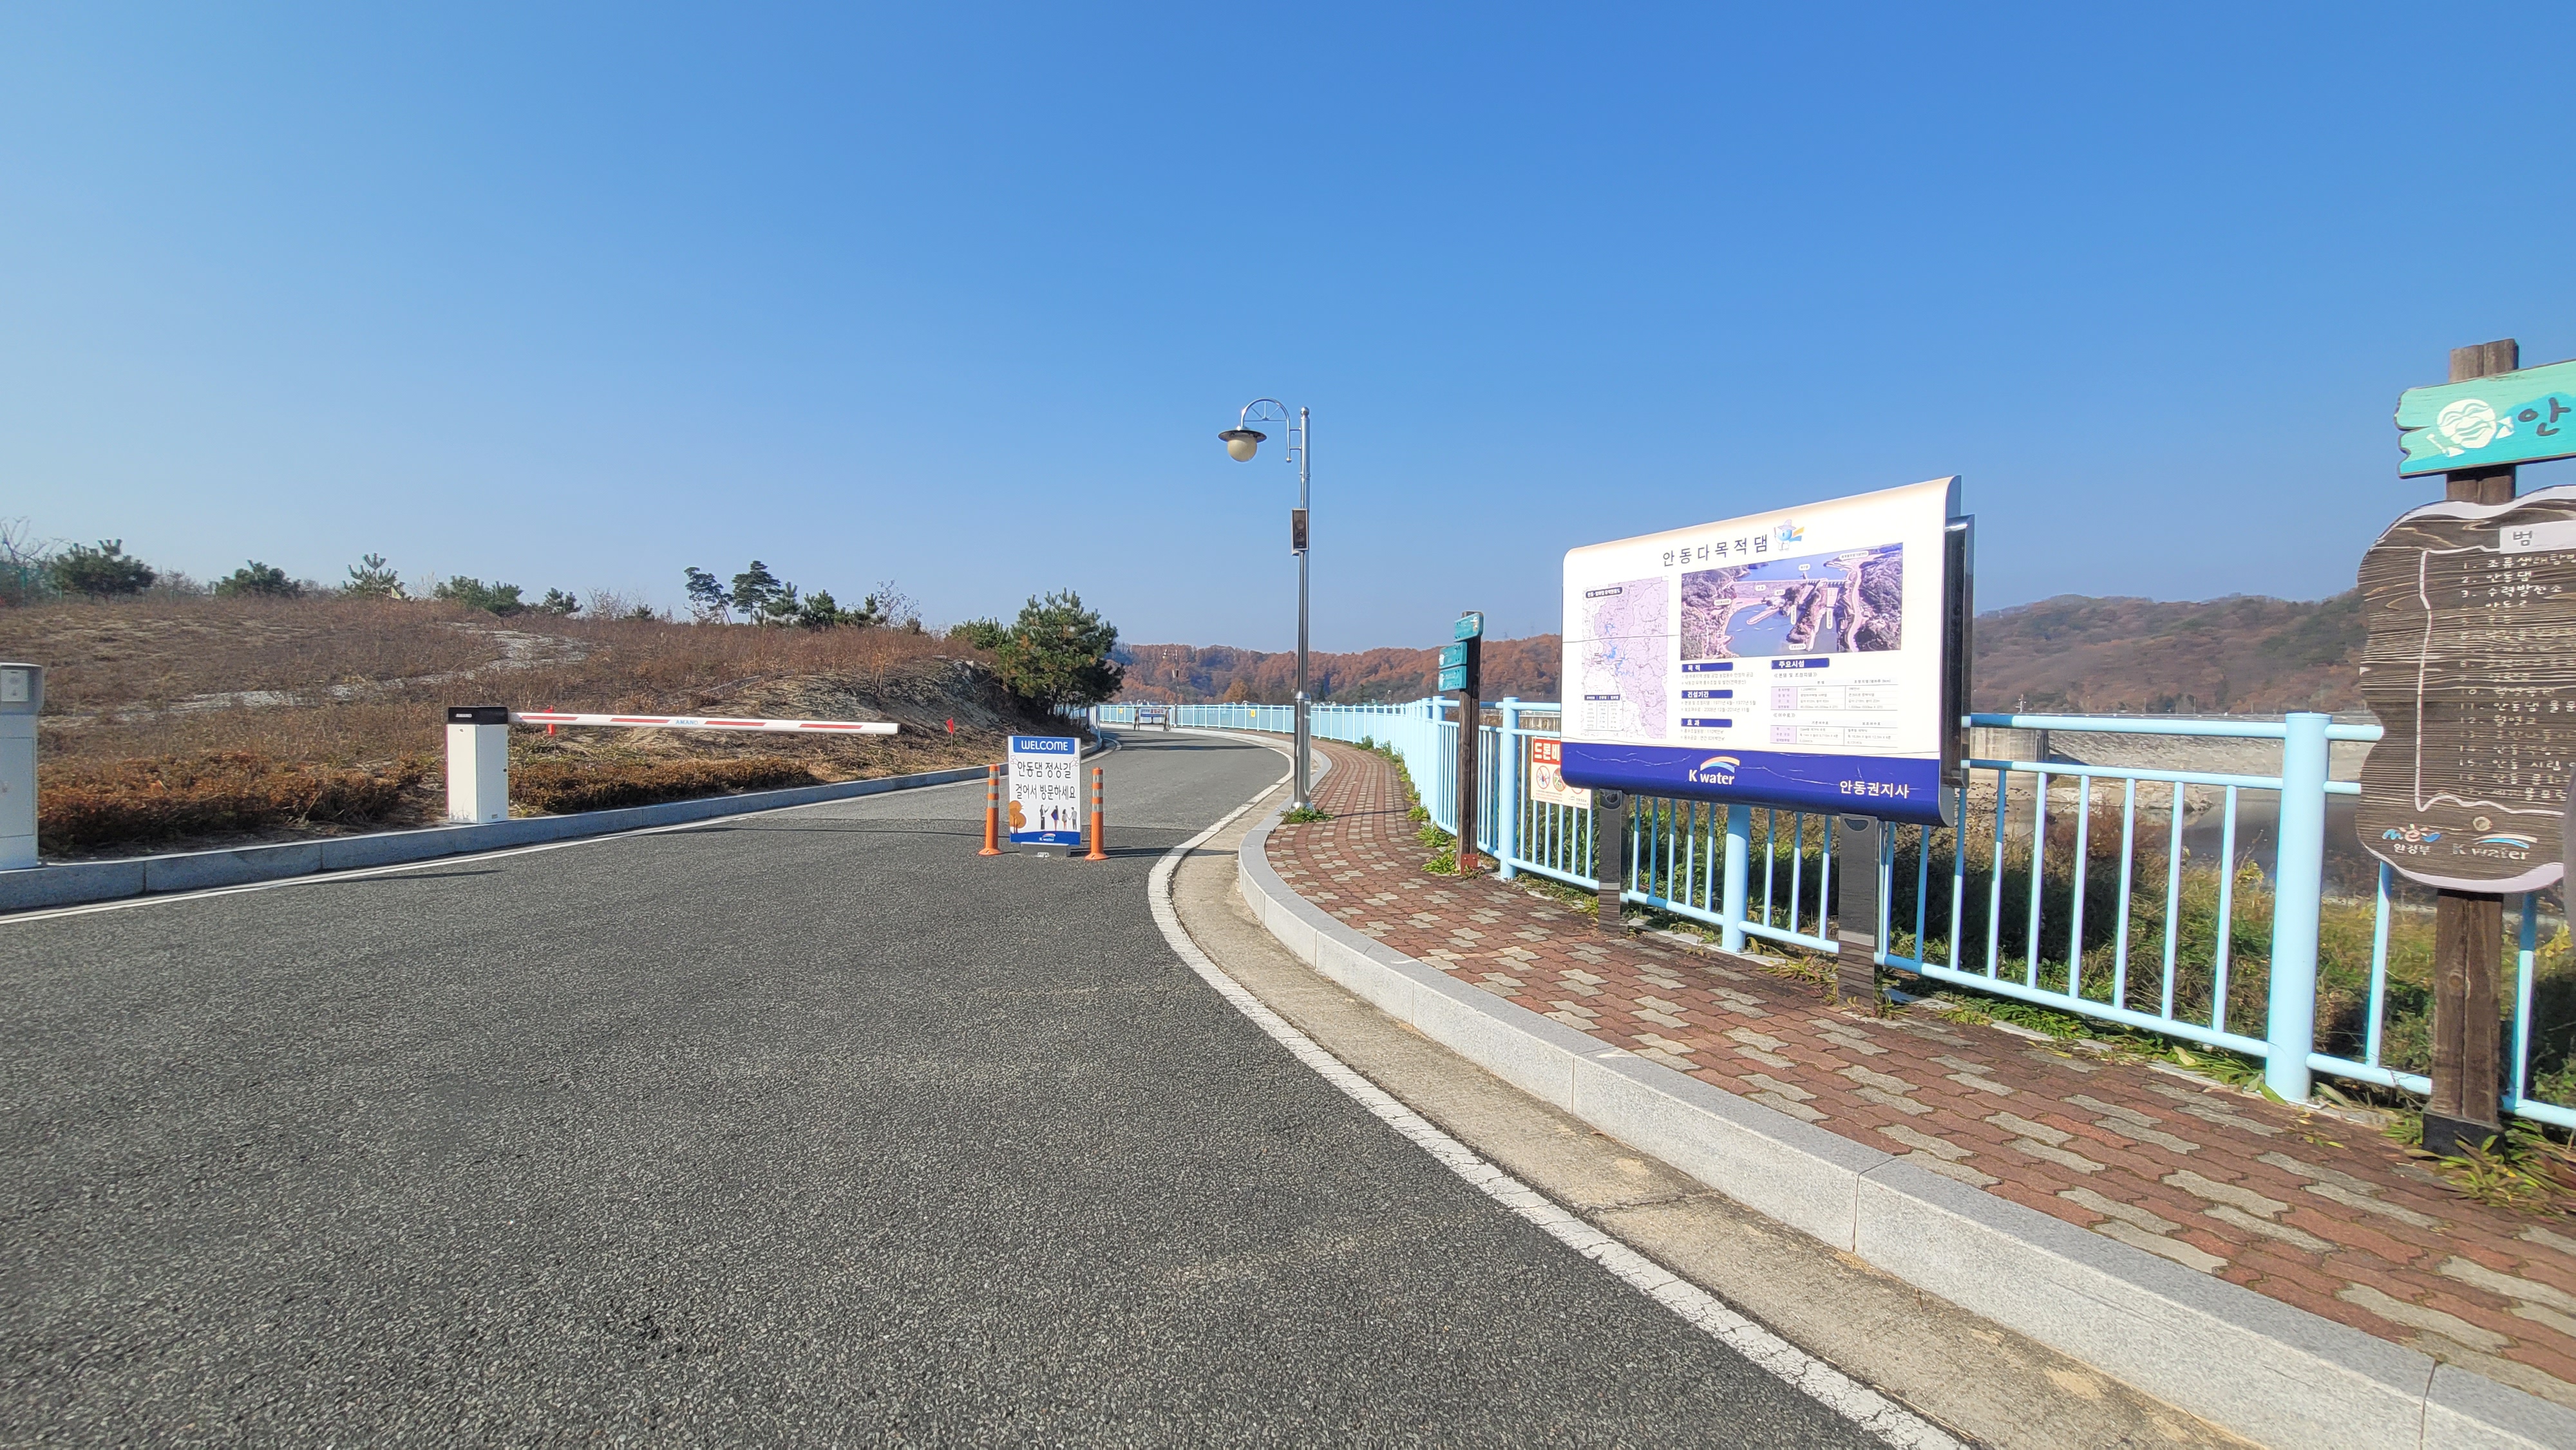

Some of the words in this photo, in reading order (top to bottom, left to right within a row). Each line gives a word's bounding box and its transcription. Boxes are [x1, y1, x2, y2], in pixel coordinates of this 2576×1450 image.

[2517, 397, 2571, 437] 안
[1663, 534, 1767, 567] 안동다목적댐
[2486, 570, 2532, 583] 안동댐
[2487, 584, 2562, 597] 수력발전소
[1021, 740, 1068, 751] WELCOME
[1018, 761, 1043, 777] 안동댐
[1045, 762, 1072, 778] 정상길
[1689, 769, 1698, 782] K
[1700, 772, 1735, 785] water
[1015, 783, 1037, 799] 걸어서
[1039, 784, 1076, 800] 방문하세요
[1840, 780, 1909, 798] 안동권지사
[2472, 847, 2530, 860] water
